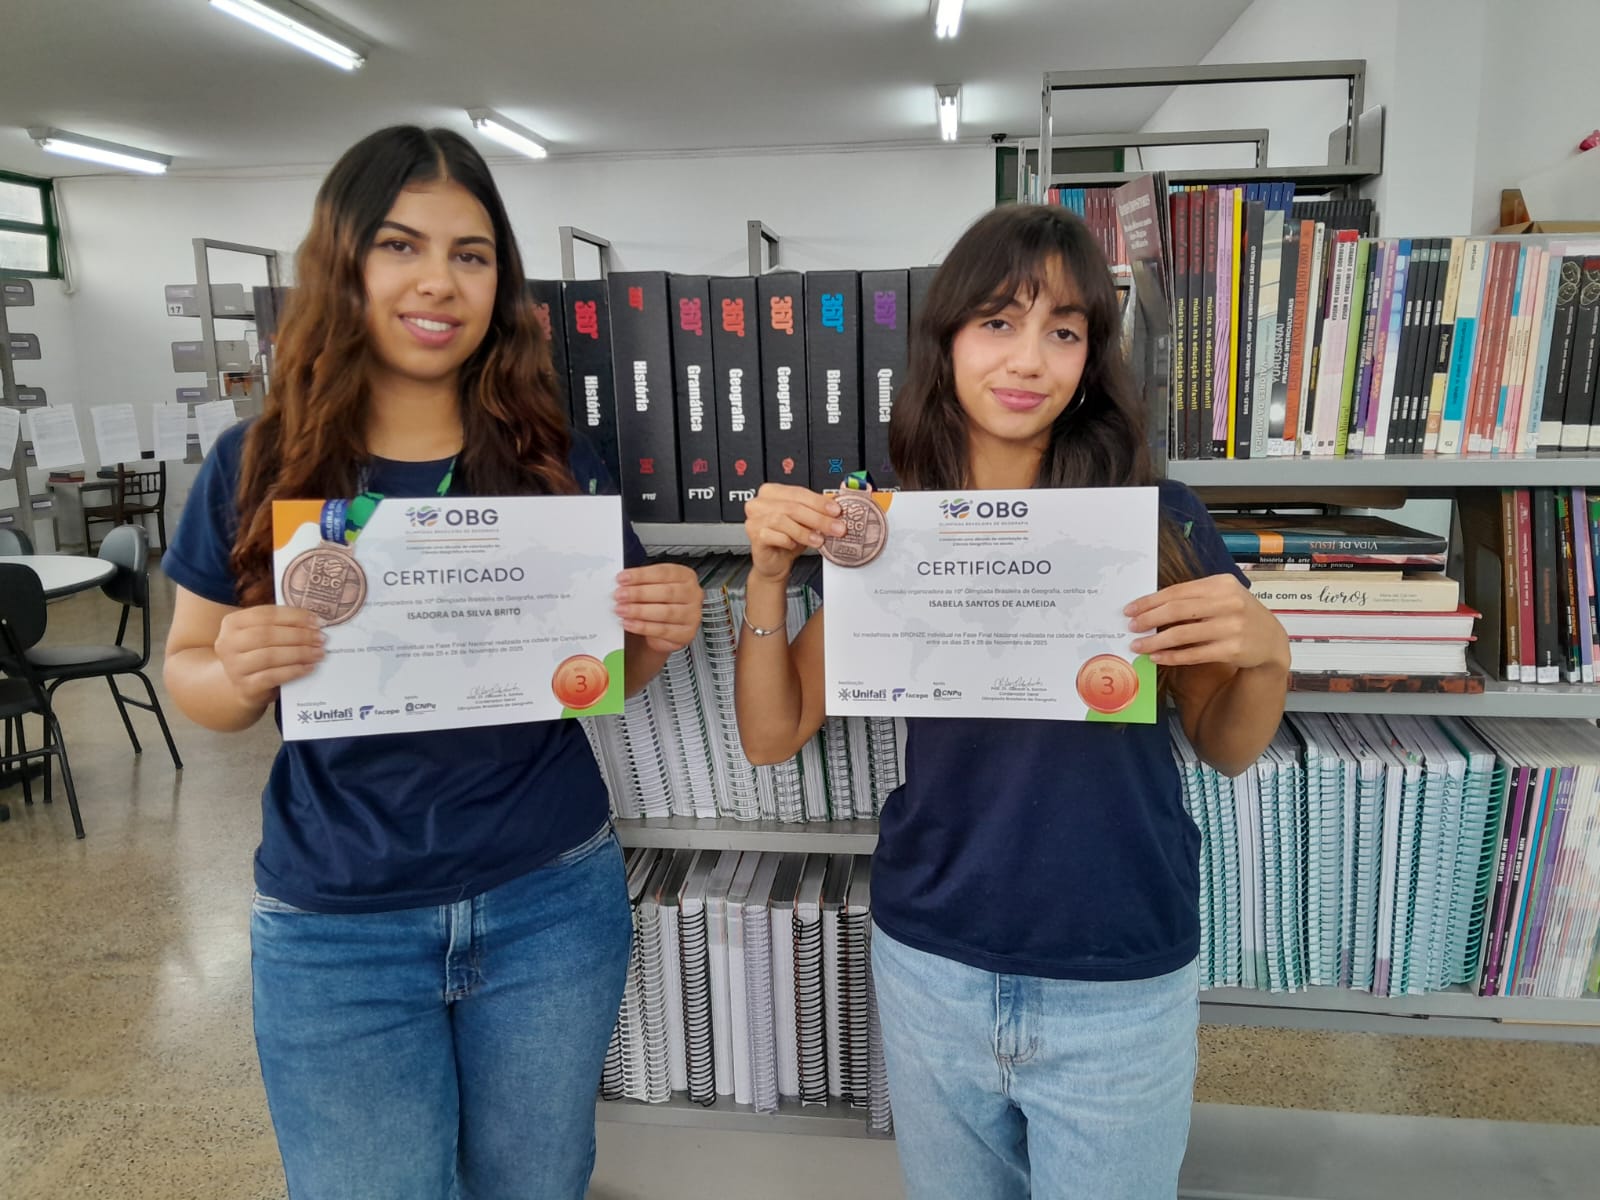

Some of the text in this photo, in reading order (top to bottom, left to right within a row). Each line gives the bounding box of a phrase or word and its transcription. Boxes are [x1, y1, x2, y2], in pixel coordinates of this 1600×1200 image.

[170, 306, 181, 314] 17
[1178, 298, 1186, 327] música
[1206, 296, 1214, 326] música
[1178, 329, 1184, 339] na
[1193, 329, 1198, 339] na
[1206, 328, 1212, 338] na
[1177, 342, 1185, 379] educação
[1191, 341, 1199, 379] educação
[1204, 340, 1213, 378] educação
[633, 361, 649, 411] História
[877, 368, 893, 422] Química
[584, 376, 600, 426] História
[687, 365, 703, 431] Gramática
[729, 368, 745, 431] Geografia
[777, 366, 793, 429] Geografia
[826, 369, 841, 423] Biologia
[688, 488, 714, 499] FTD
[729, 489, 754, 501] FTD
[445, 508, 499, 526] OBG
[976, 501, 1029, 519] OBG
[1311, 541, 1378, 551] VIDA DE JESUS
[383, 567, 525, 586] CERTIFICADO
[917, 560, 1052, 575] CERTIFICADO
[929, 600, 1057, 608] ISABELA SANTOS DE ALMEIDA
[1253, 591, 1273, 601] vida
[1275, 592, 1298, 601] com
[1300, 593, 1312, 601] os
[1318, 584, 1367, 606] livros
[407, 607, 521, 620] ISADORA DA SILVA BRITO
[575, 674, 587, 693] 3
[1101, 676, 1114, 696] 3
[852, 689, 884, 699] Unifal
[313, 708, 350, 720] Unifal
